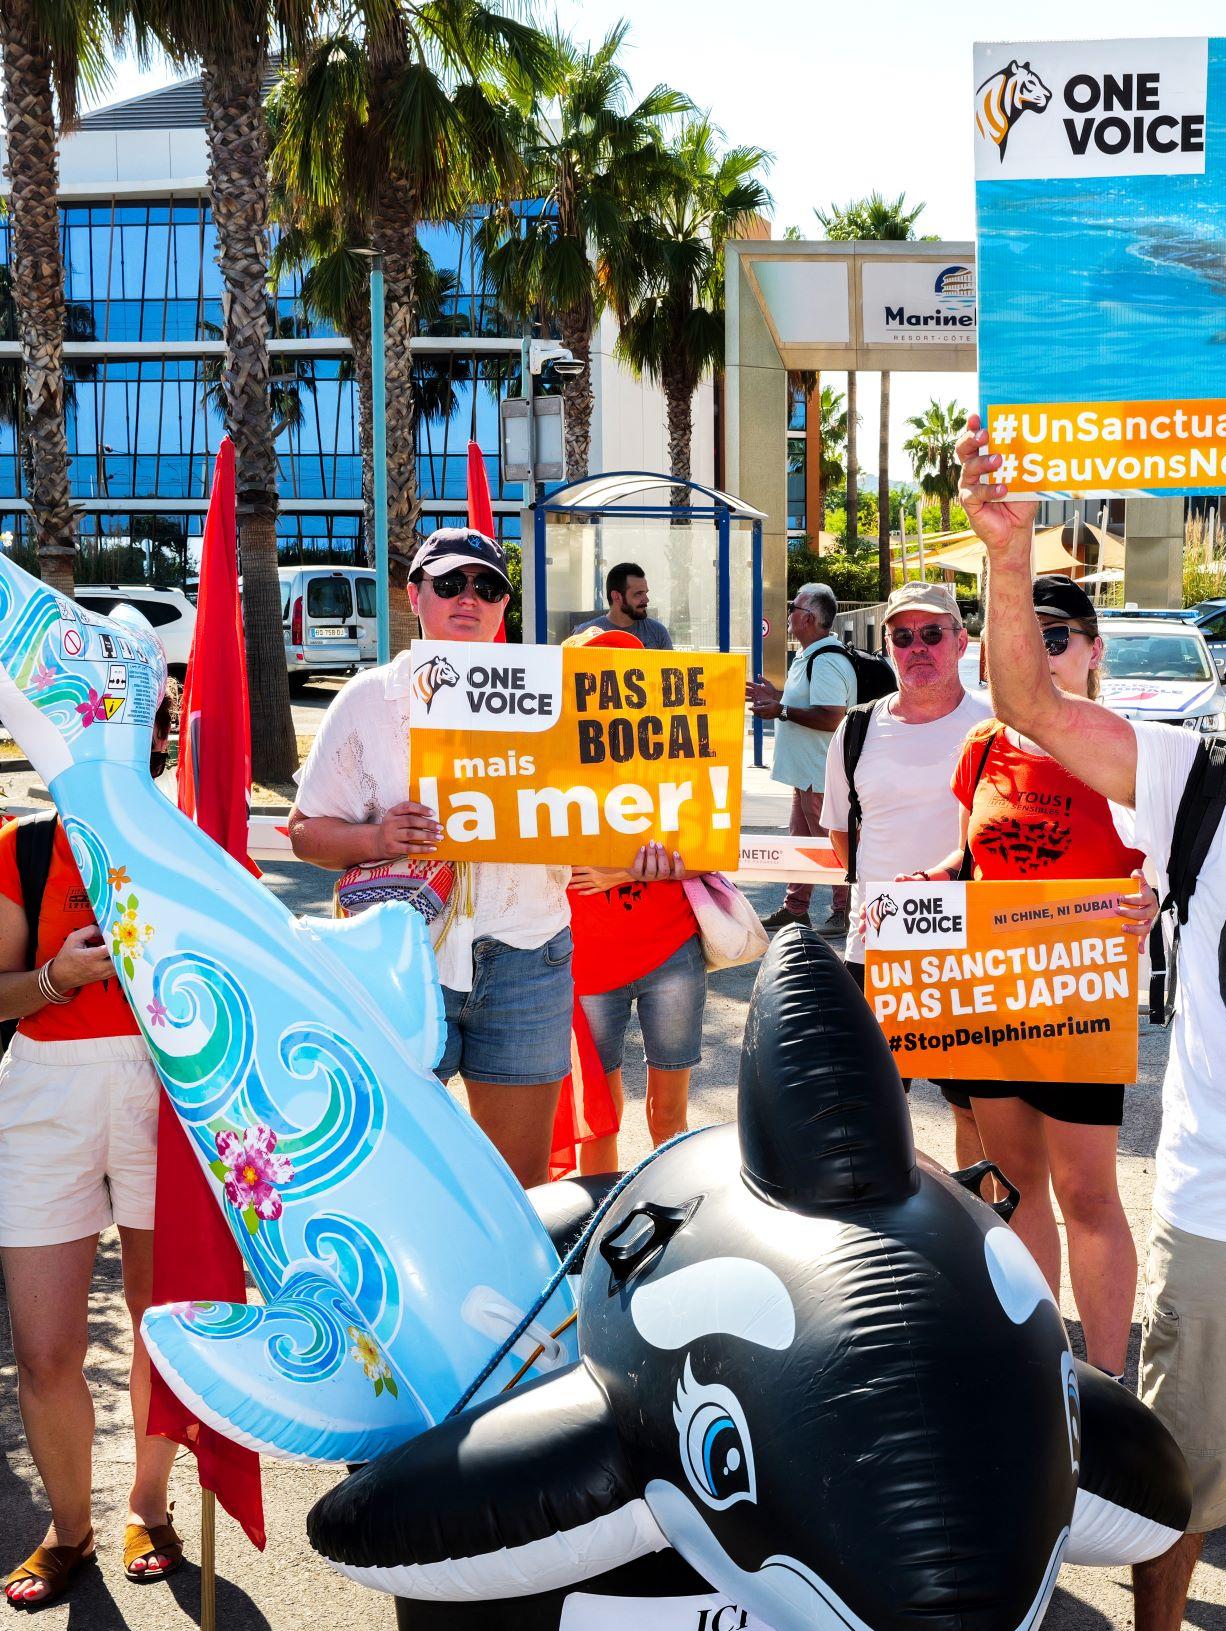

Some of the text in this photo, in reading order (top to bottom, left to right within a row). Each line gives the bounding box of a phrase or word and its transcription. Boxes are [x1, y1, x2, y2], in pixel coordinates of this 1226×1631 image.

[1063, 73, 1160, 113] ONE
[1063, 115, 1205, 155] VOICE
[885, 306, 976, 326] Marine
[467, 666, 526, 690] ONE
[574, 666, 706, 712] PAS DE
[466, 691, 553, 716] VOICE
[578, 714, 717, 764] BOCAL
[453, 750, 536, 778] mais
[418, 777, 497, 843] la
[517, 781, 693, 839] mer
[1018, 791, 1062, 807] TOUS
[739, 849, 780, 860] NETIC
[903, 897, 943, 916] ONE
[994, 914, 1007, 925] NI
[1011, 908, 1054, 924] CHINE,
[1057, 905, 1071, 917] NI
[1074, 900, 1113, 914] DUBAI
[904, 915, 962, 935] VOICE
[870, 936, 1128, 989] UN SANCTUAIRE
[874, 968, 1129, 1023] PAS LE JAPON
[888, 1016, 1111, 1052] #StopDelphinarium
